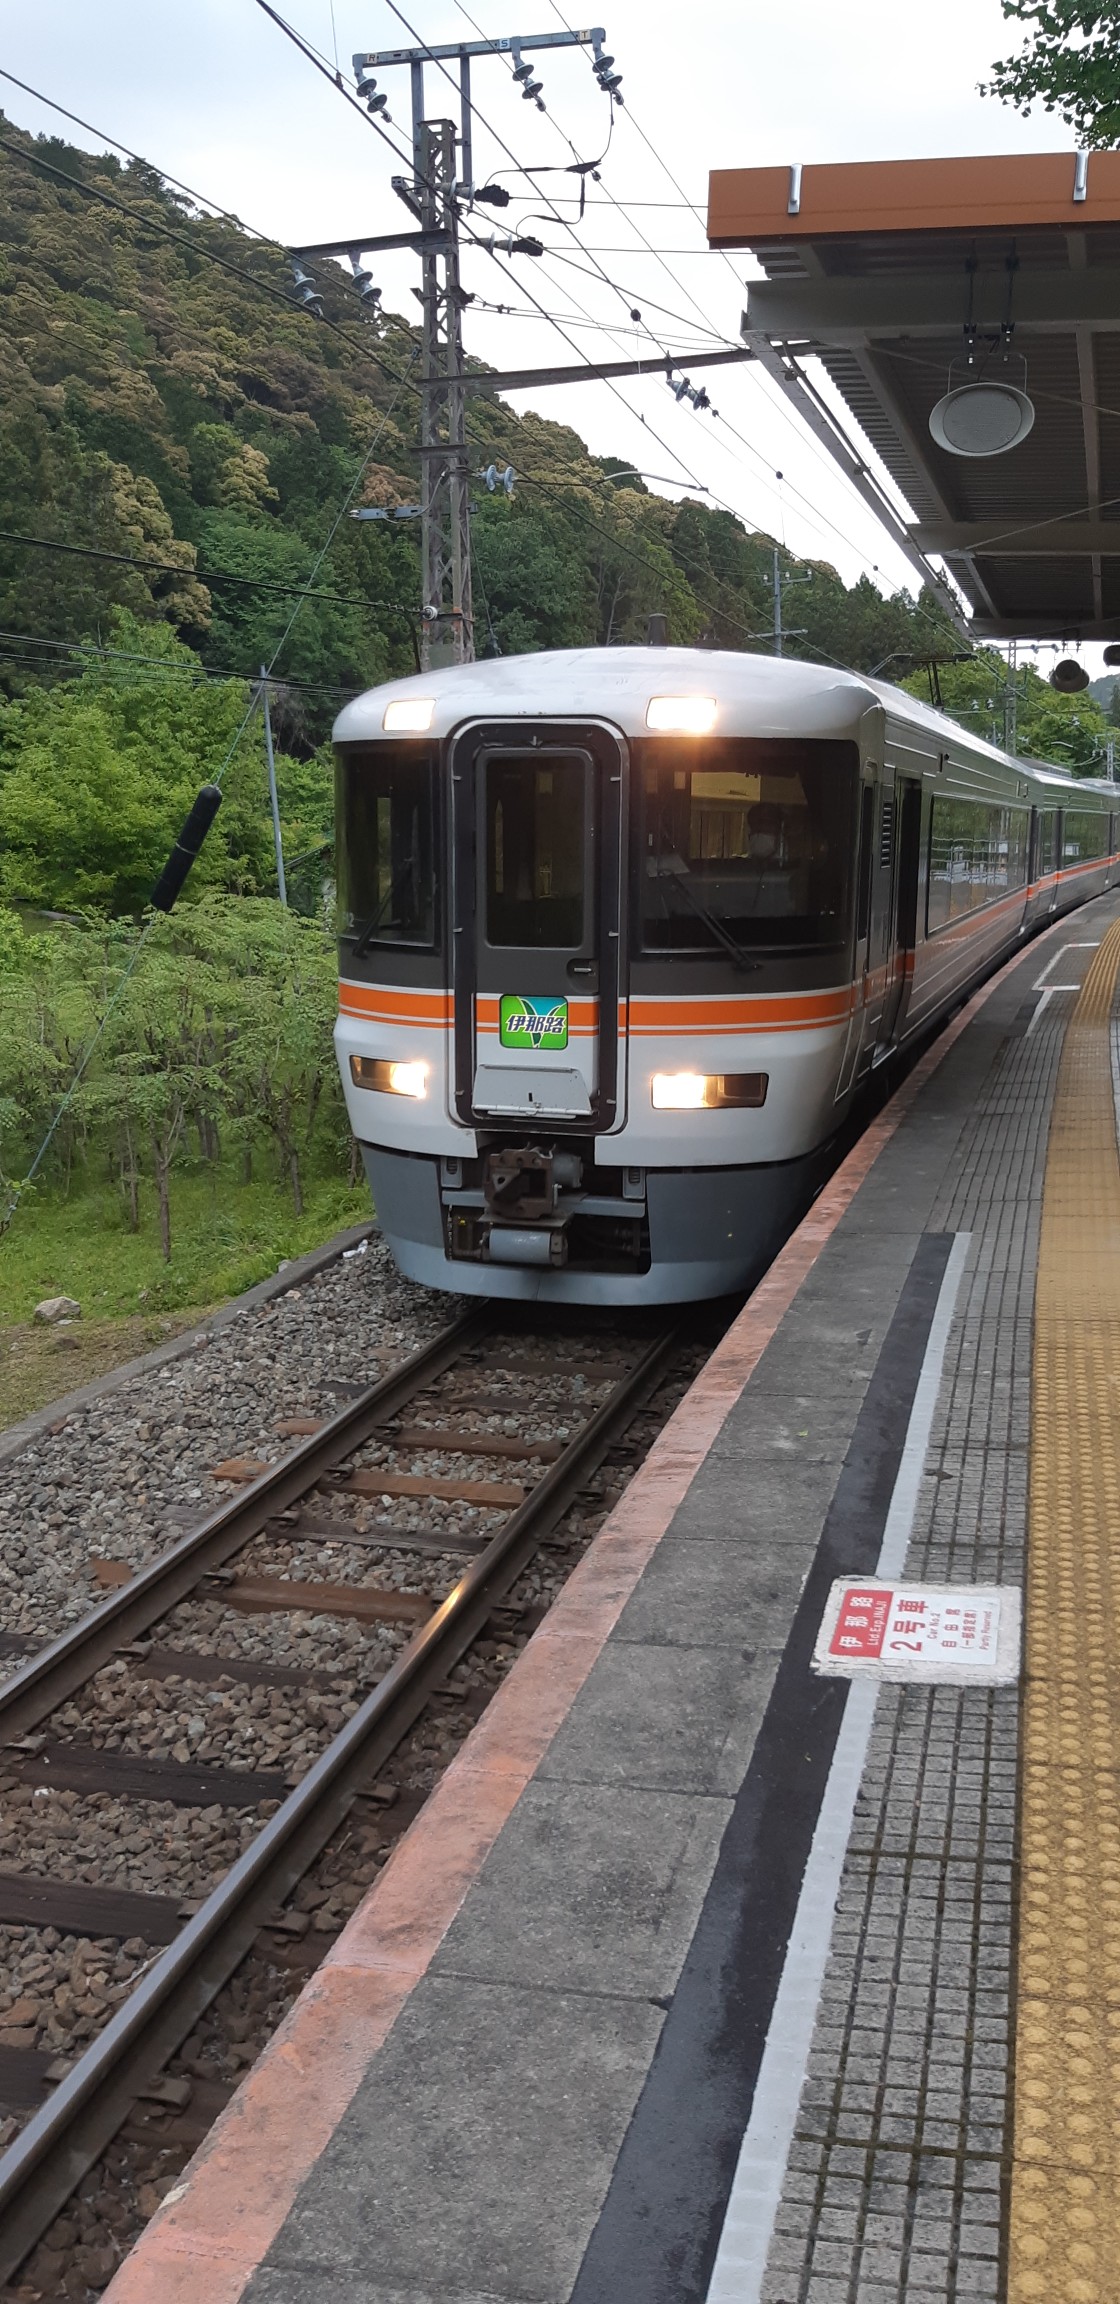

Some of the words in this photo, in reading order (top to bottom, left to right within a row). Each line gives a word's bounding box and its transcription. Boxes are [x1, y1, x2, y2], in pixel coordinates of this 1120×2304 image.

[581, 30, 589, 39] T
[501, 39, 508, 48] S
[368, 54, 376, 63] R
[506, 1014, 566, 1034] 伊那路
[839, 1596, 873, 1648] 伊那路
[889, 1599, 929, 1652] 2号車
[930, 1612, 941, 1627] No.2
[927, 1626, 938, 1640] Car
[941, 1608, 960, 1648] 自由席
[979, 1633, 990, 1651] Partly
